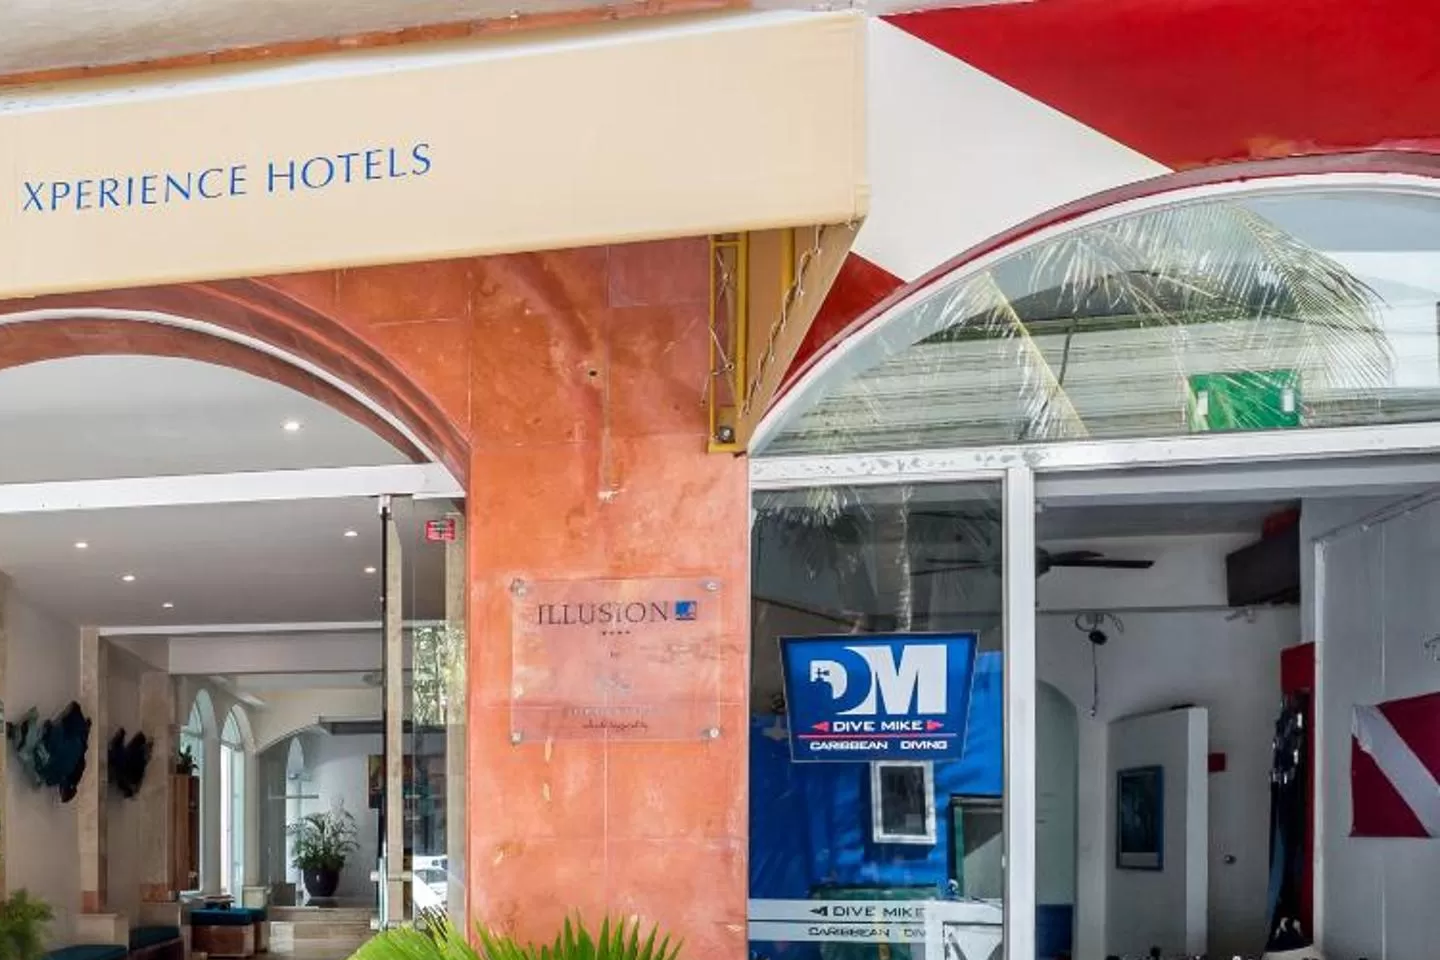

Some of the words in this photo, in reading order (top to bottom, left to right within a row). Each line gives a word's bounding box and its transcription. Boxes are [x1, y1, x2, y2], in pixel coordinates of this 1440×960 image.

[22, 164, 248, 212] XPERIENCE
[267, 143, 432, 192] HOTELS
[538, 600, 669, 626] ILLUSION
[810, 644, 948, 715] DM
[832, 721, 876, 733] DIVE
[881, 719, 923, 732] MIKE
[810, 740, 888, 751] CARIBBEAN
[900, 740, 948, 750] DIVING
[832, 906, 875, 917] DIVE
